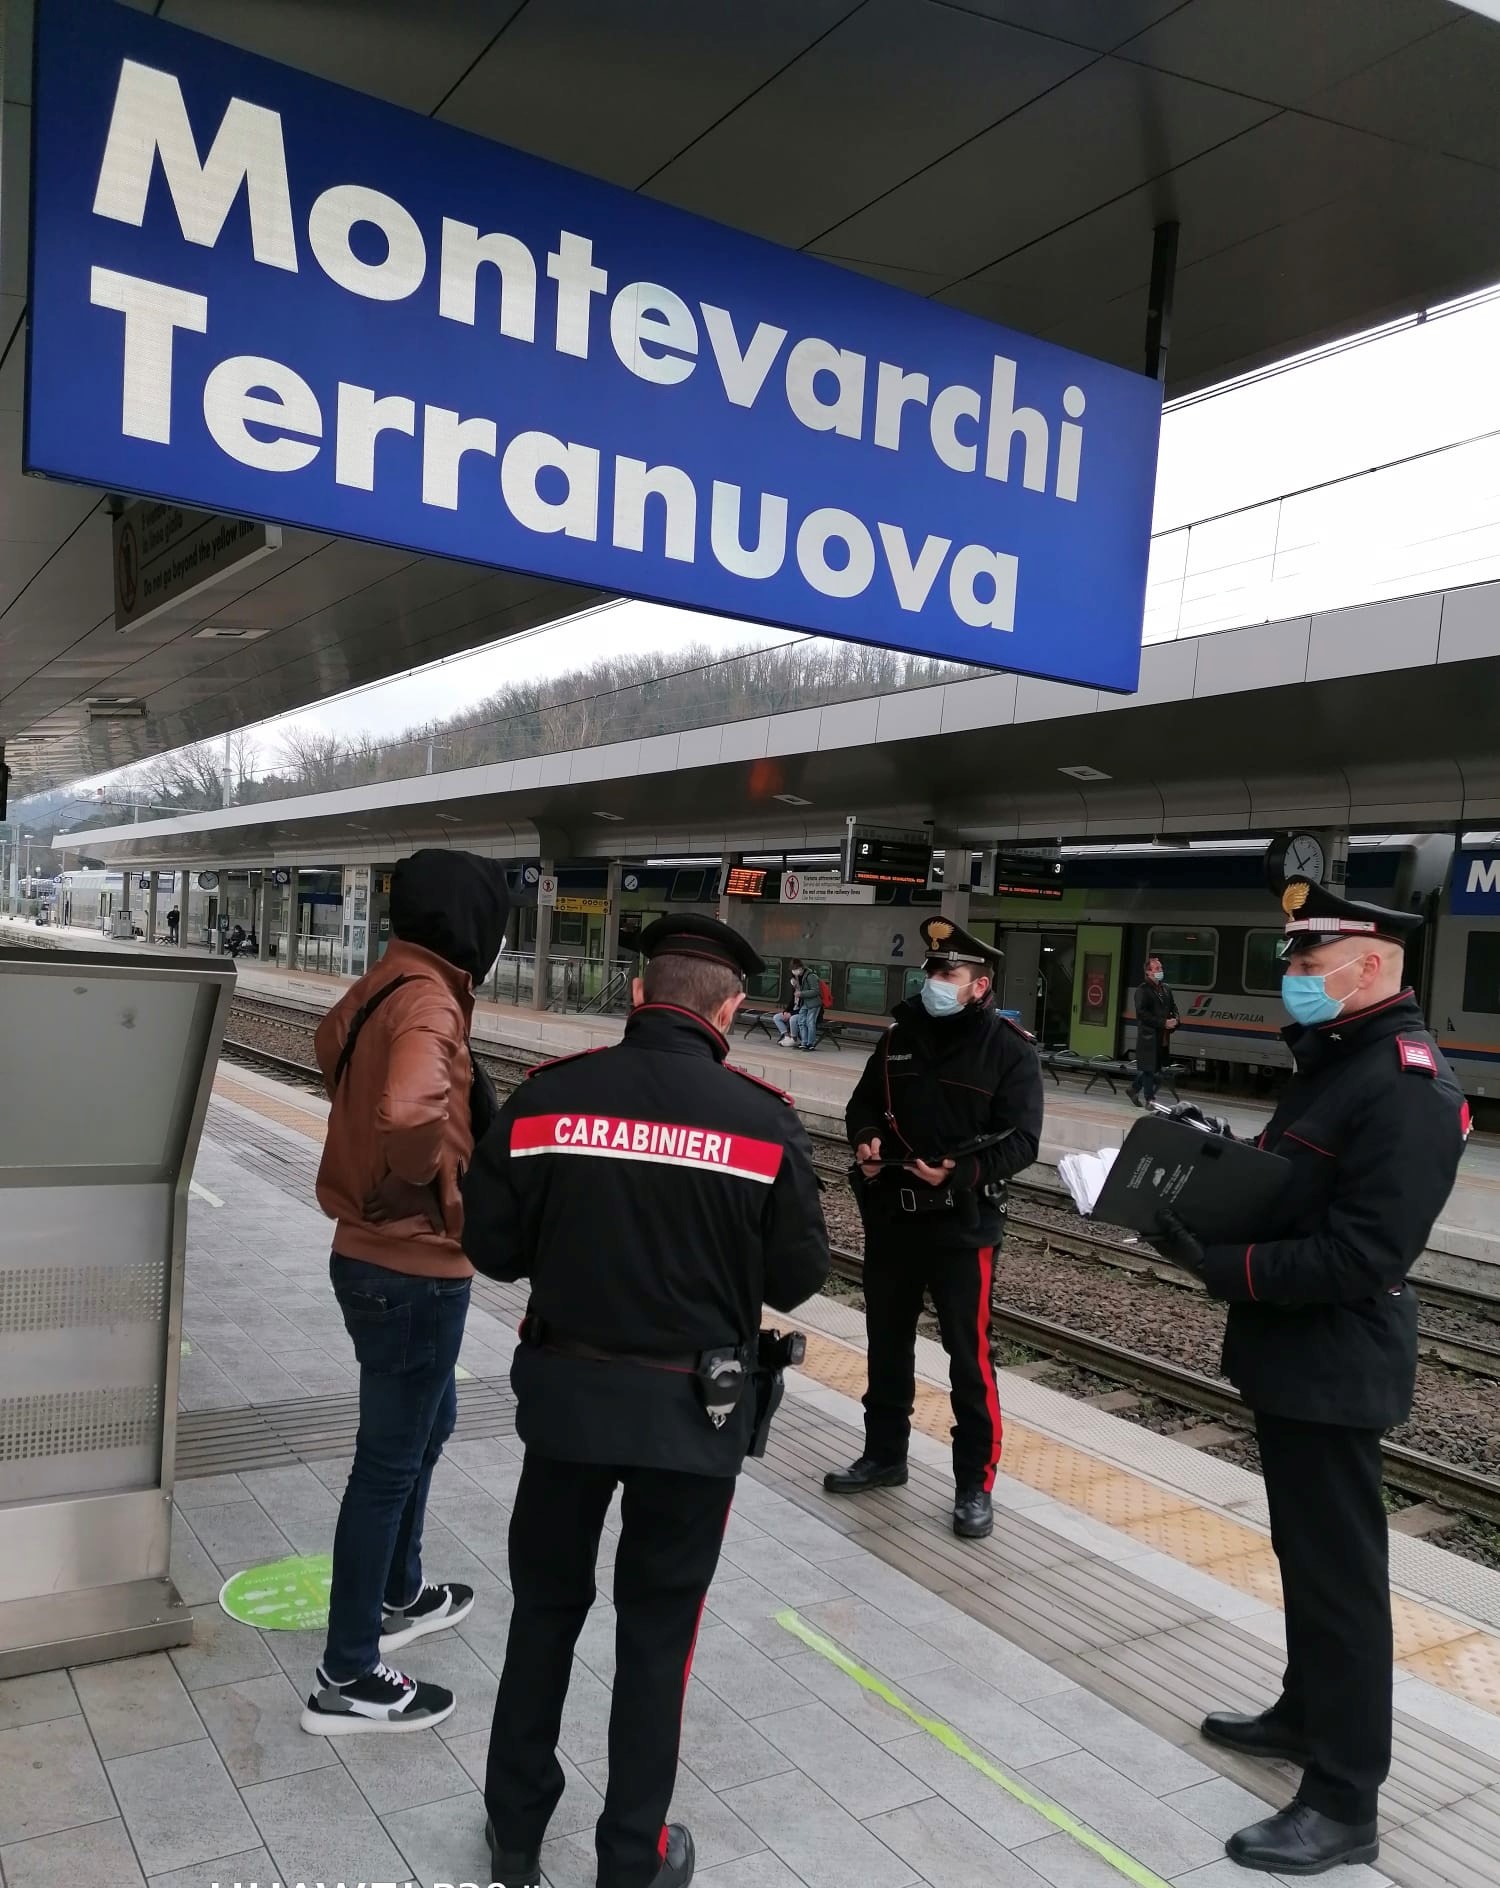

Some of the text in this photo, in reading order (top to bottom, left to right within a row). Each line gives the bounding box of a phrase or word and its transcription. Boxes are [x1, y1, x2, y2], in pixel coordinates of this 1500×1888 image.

[92, 58, 1086, 503] Montevarchi
[90, 266, 1019, 634] Terranuova
[153, 572, 162, 591] not
[164, 567, 171, 590] go
[172, 543, 197, 580] beyond
[198, 540, 211, 562] the
[211, 522, 238, 561] yellow
[862, 843, 869, 855] 2
[1054, 863, 1061, 873] 3
[1466, 860, 1500, 892] M
[891, 933, 905, 957] 2
[1210, 1010, 1264, 1023] TRENITALIA
[554, 1117, 732, 1164] CARABINIERI
